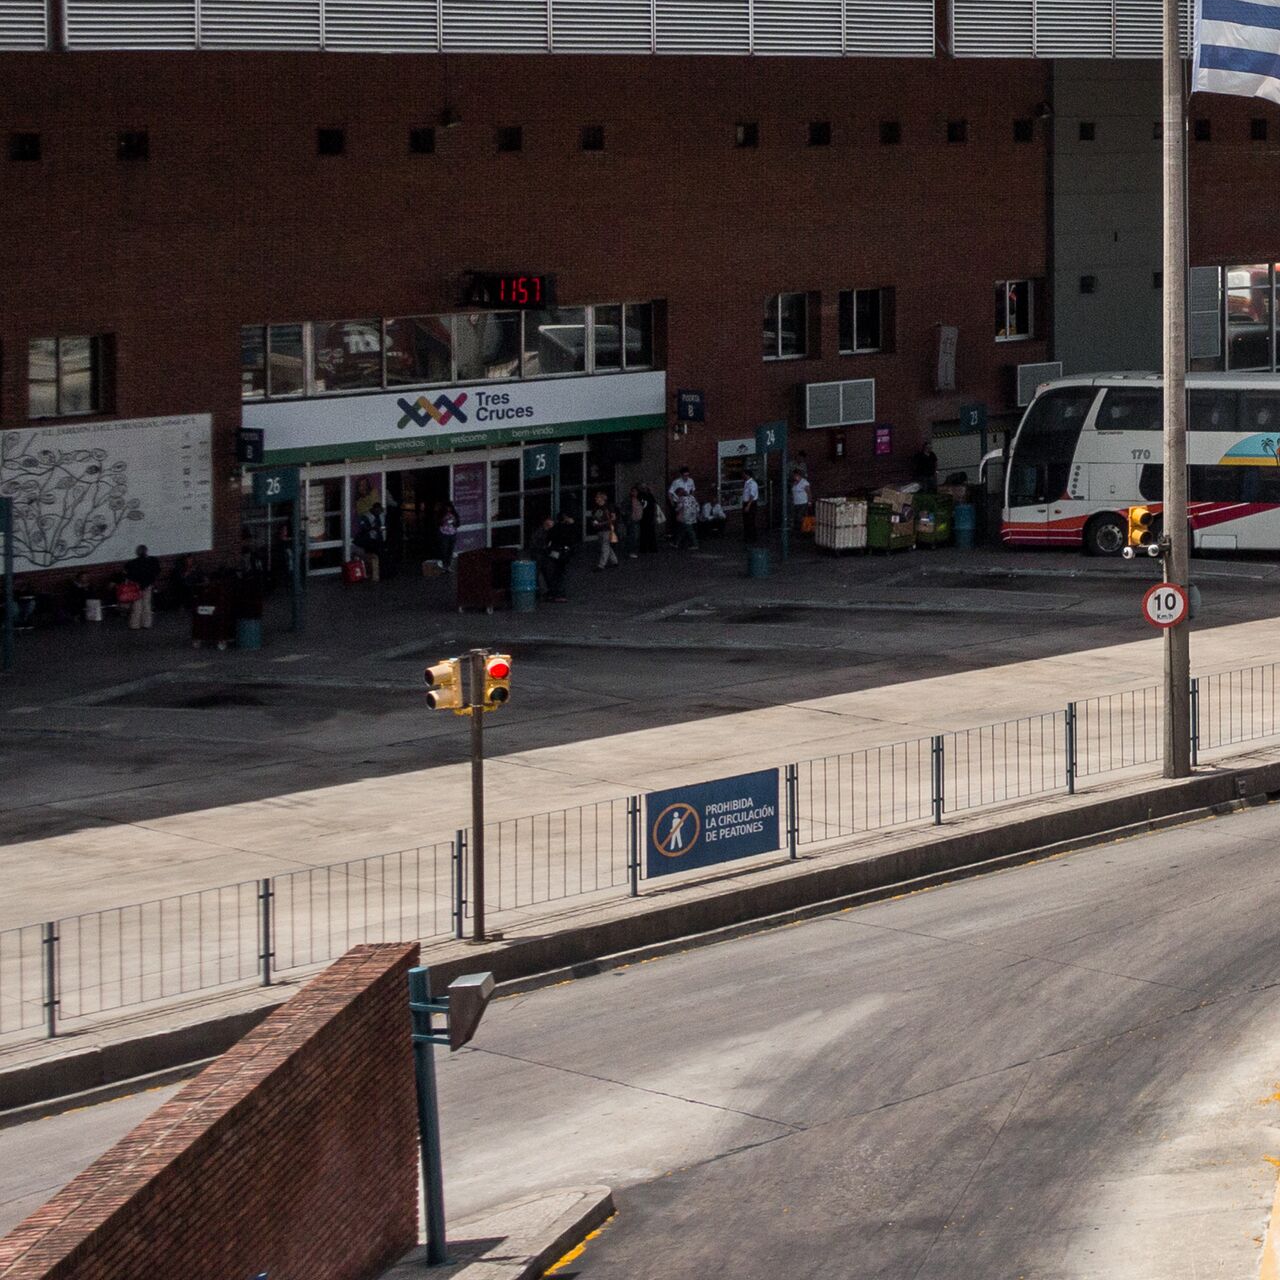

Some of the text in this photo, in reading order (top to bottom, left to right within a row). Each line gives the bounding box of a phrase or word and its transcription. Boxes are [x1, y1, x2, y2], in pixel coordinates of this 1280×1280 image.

[475, 392, 510, 406] Tres
[476, 405, 534, 421] Cruces
[375, 438, 426, 451] bienvenidos
[450, 433, 488, 444] welcome
[535, 453, 546, 471] 25
[1131, 449, 1151, 460] 170
[266, 477, 281, 495] 26
[1154, 592, 1176, 611] 10
[706, 797, 754, 815] PROHIBIDA
[706, 804, 775, 829] LA CIRCULACIÓN
[706, 821, 764, 842] DE PEATONES
